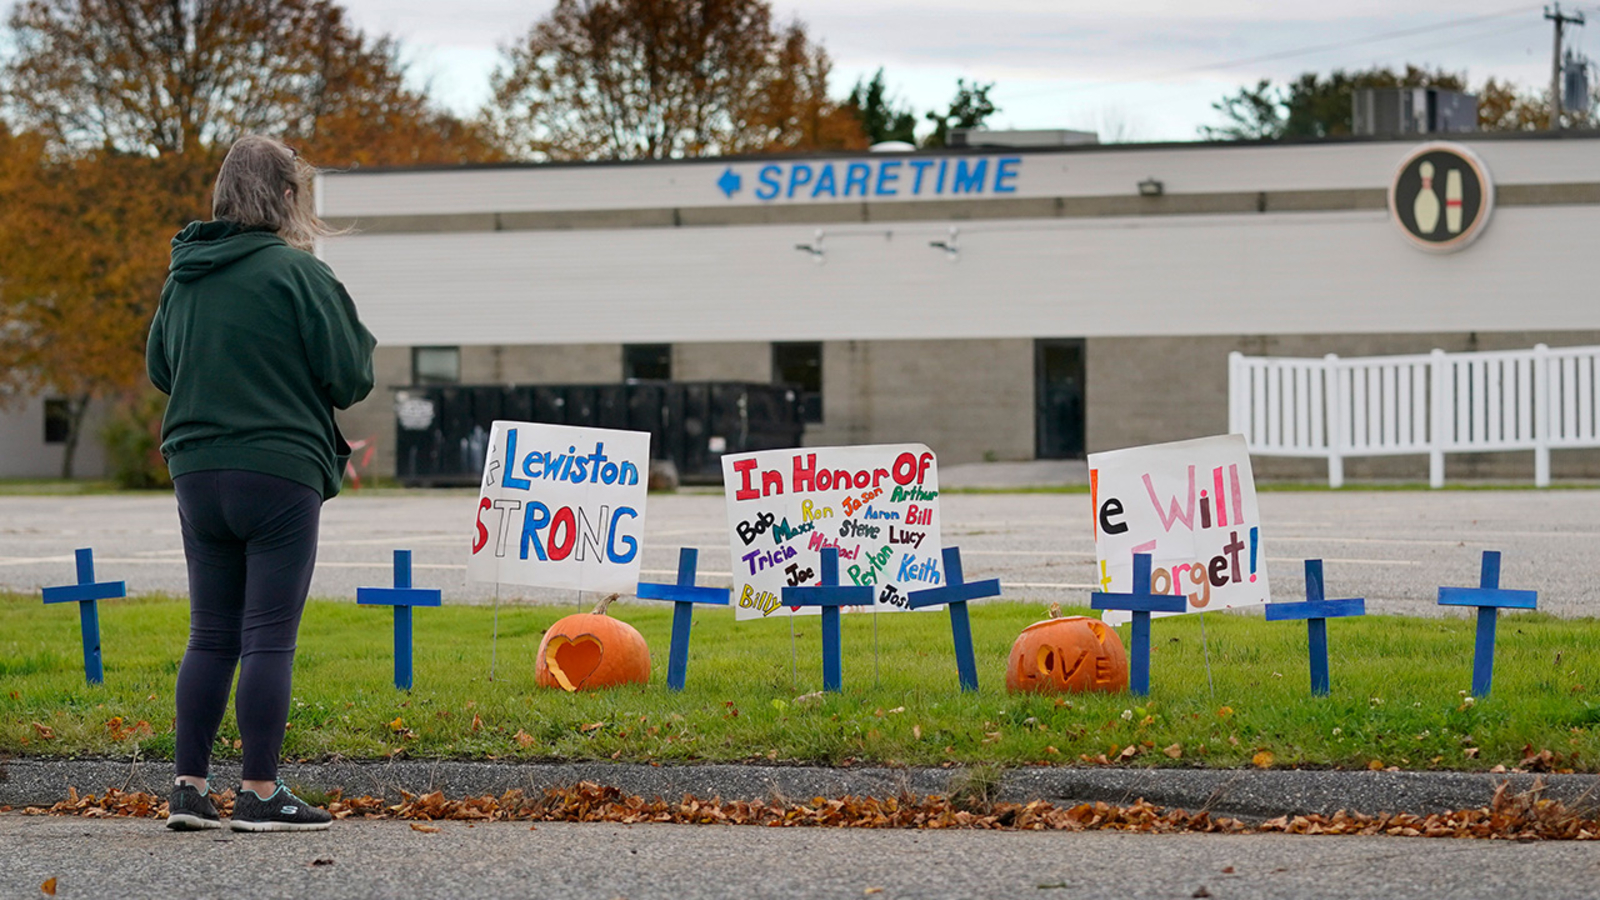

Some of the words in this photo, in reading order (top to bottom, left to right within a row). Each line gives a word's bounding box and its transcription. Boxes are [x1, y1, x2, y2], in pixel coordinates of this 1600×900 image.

[755, 157, 1022, 201] SPARETIME
[501, 428, 638, 490] Lewiston
[733, 458, 783, 501] In
[792, 453, 890, 493] Honor
[892, 452, 934, 485] Of
[841, 487, 884, 517] Jason
[890, 485, 939, 503] Arthur
[1141, 464, 1244, 532] Will
[801, 499, 834, 522] Ron
[864, 505, 900, 520] Aaron
[905, 504, 933, 526] Bill
[472, 497, 638, 564] STRONG
[736, 511, 775, 546] Bob
[772, 517, 815, 545] Maxx
[839, 518, 880, 539] Steve
[889, 525, 926, 549] Lucy
[741, 545, 798, 576] Tricia
[784, 562, 815, 587] Joe
[847, 545, 894, 587] Peyton
[896, 553, 941, 585] Keith
[1131, 526, 1258, 608] orget!
[739, 583, 782, 617] Billy
[1017, 644, 1111, 684] LOVE
